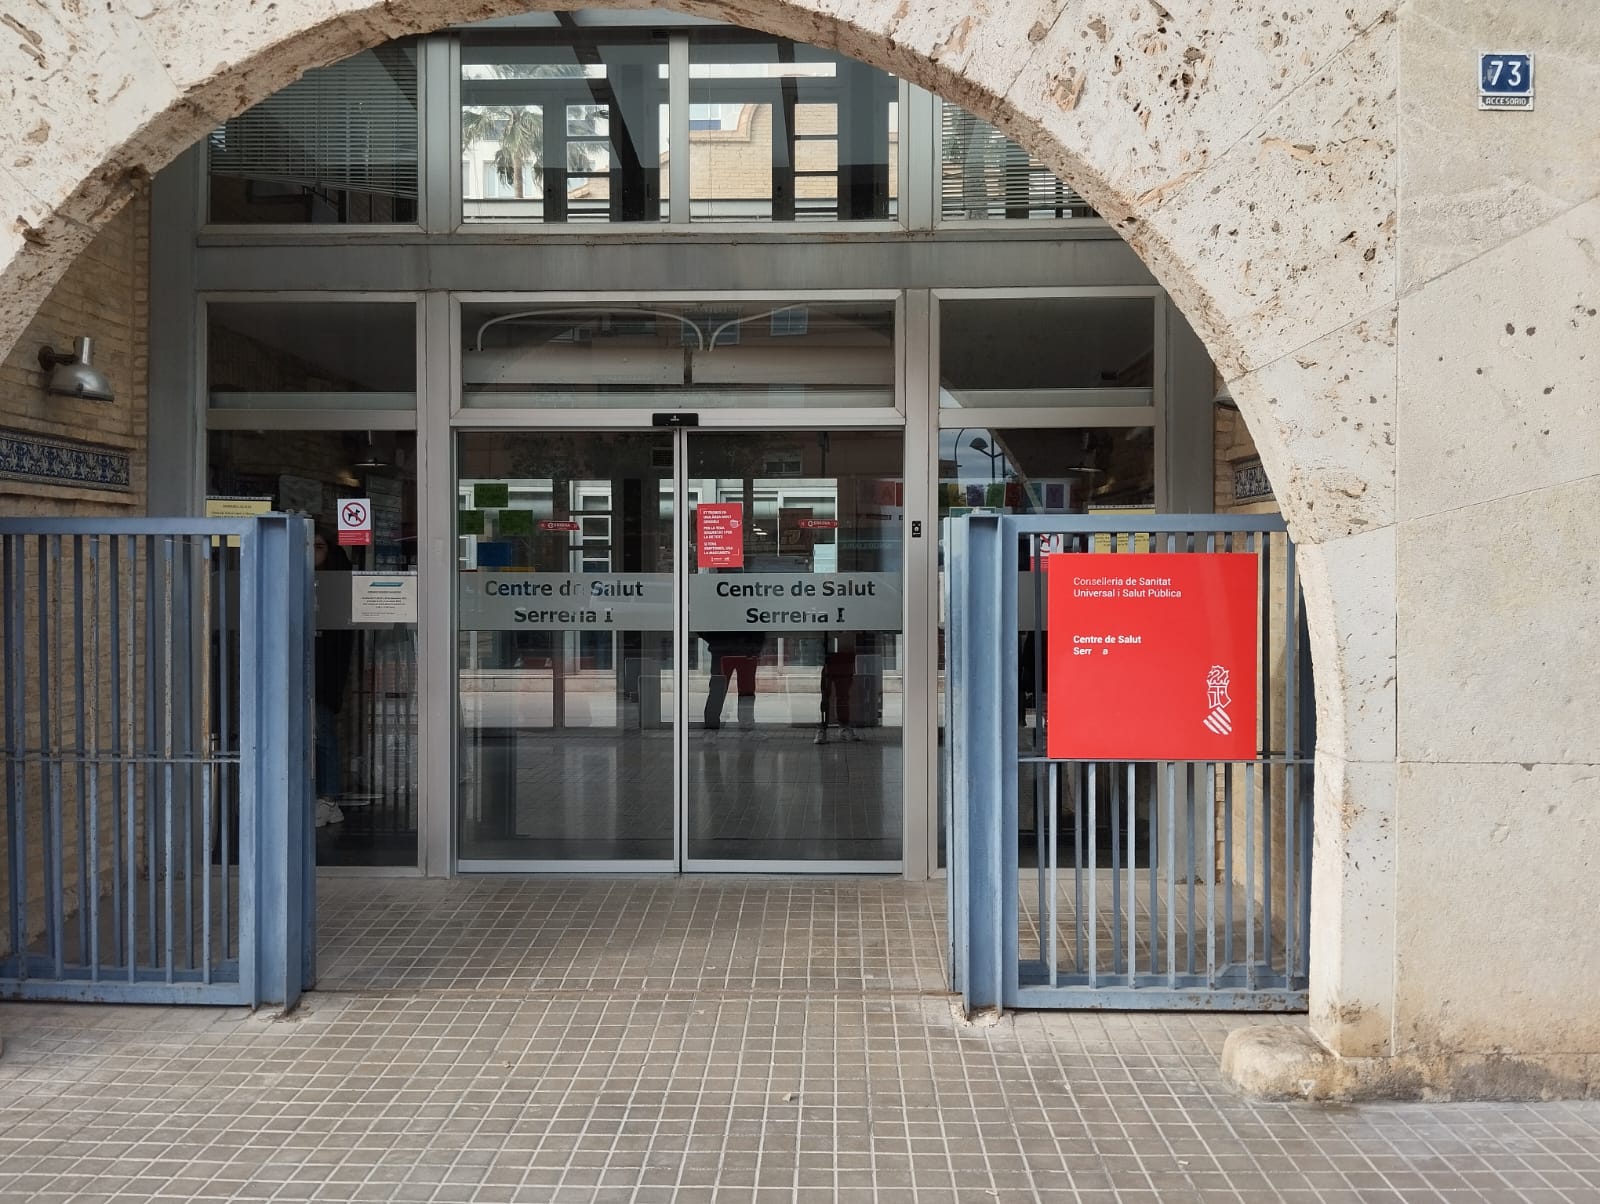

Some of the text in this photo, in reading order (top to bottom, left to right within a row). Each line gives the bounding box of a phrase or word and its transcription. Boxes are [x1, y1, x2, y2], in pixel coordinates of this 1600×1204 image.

[1490, 60, 1522, 86] 73
[1485, 97, 1527, 105] ACCESORIO
[1073, 577, 1171, 586] Conselleria de Sanitat
[485, 580, 643, 597] Centre d Salut
[716, 580, 876, 597] Centre de Salut
[1073, 588, 1115, 598] Universal
[1122, 588, 1145, 598] Salut
[1148, 588, 1182, 598] Pública
[836, 607, 846, 623] I
[1073, 635, 1142, 644] Centre de Salut
